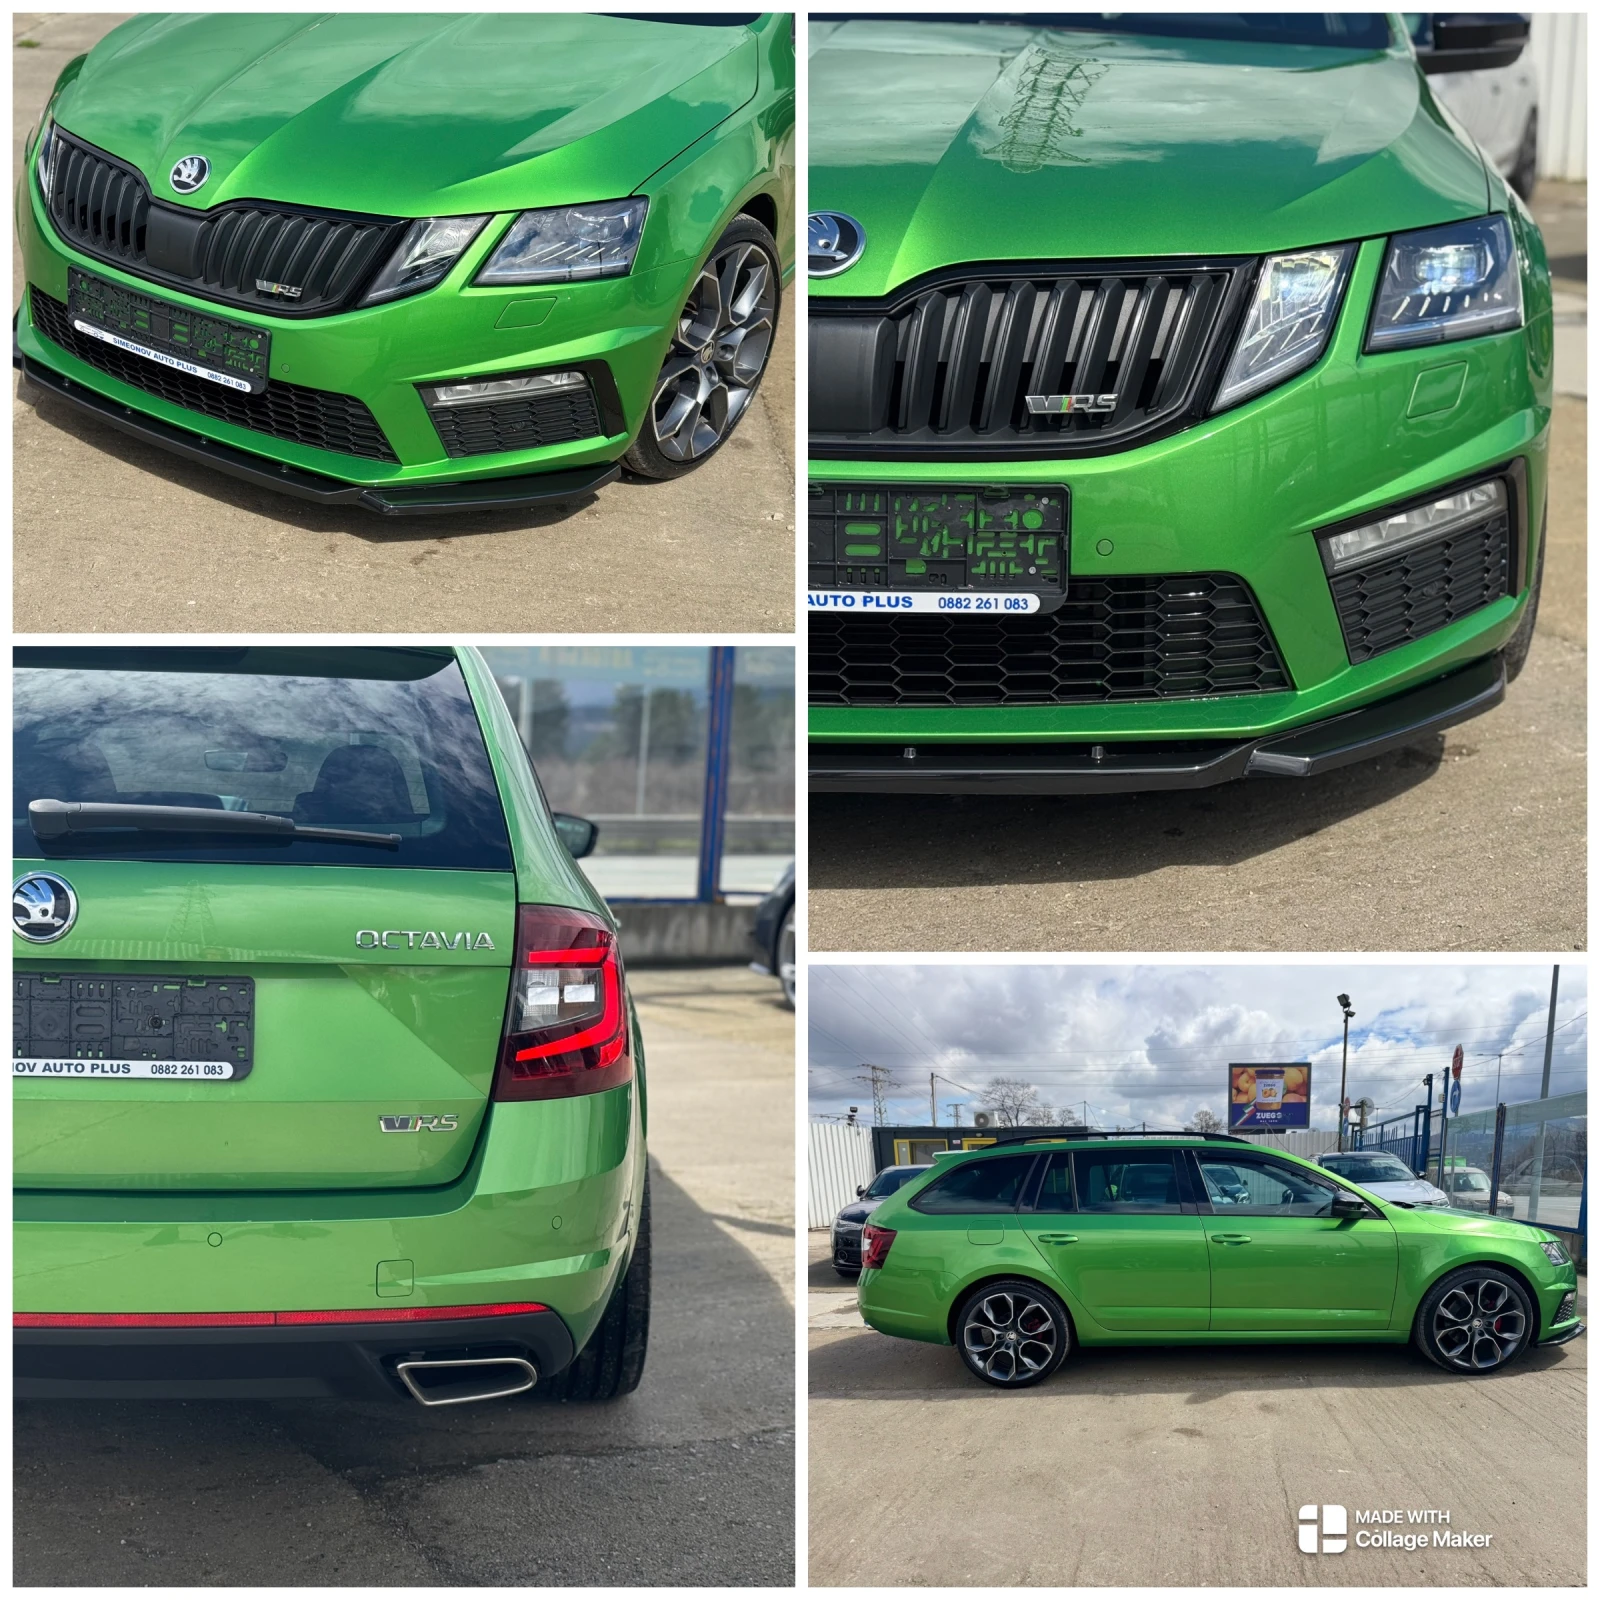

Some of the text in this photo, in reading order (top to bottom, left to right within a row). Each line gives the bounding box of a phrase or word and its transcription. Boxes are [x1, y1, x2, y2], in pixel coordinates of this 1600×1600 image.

[112, 336, 247, 391] SIMEONOV AUTO PLUS 0882 261 083
[808, 594, 1029, 611] AUTO PLUS 0882 261 083
[355, 929, 496, 951] OCTAVIA
[12, 1062, 224, 1076] OV AUTO PLUS 0882 261 083
